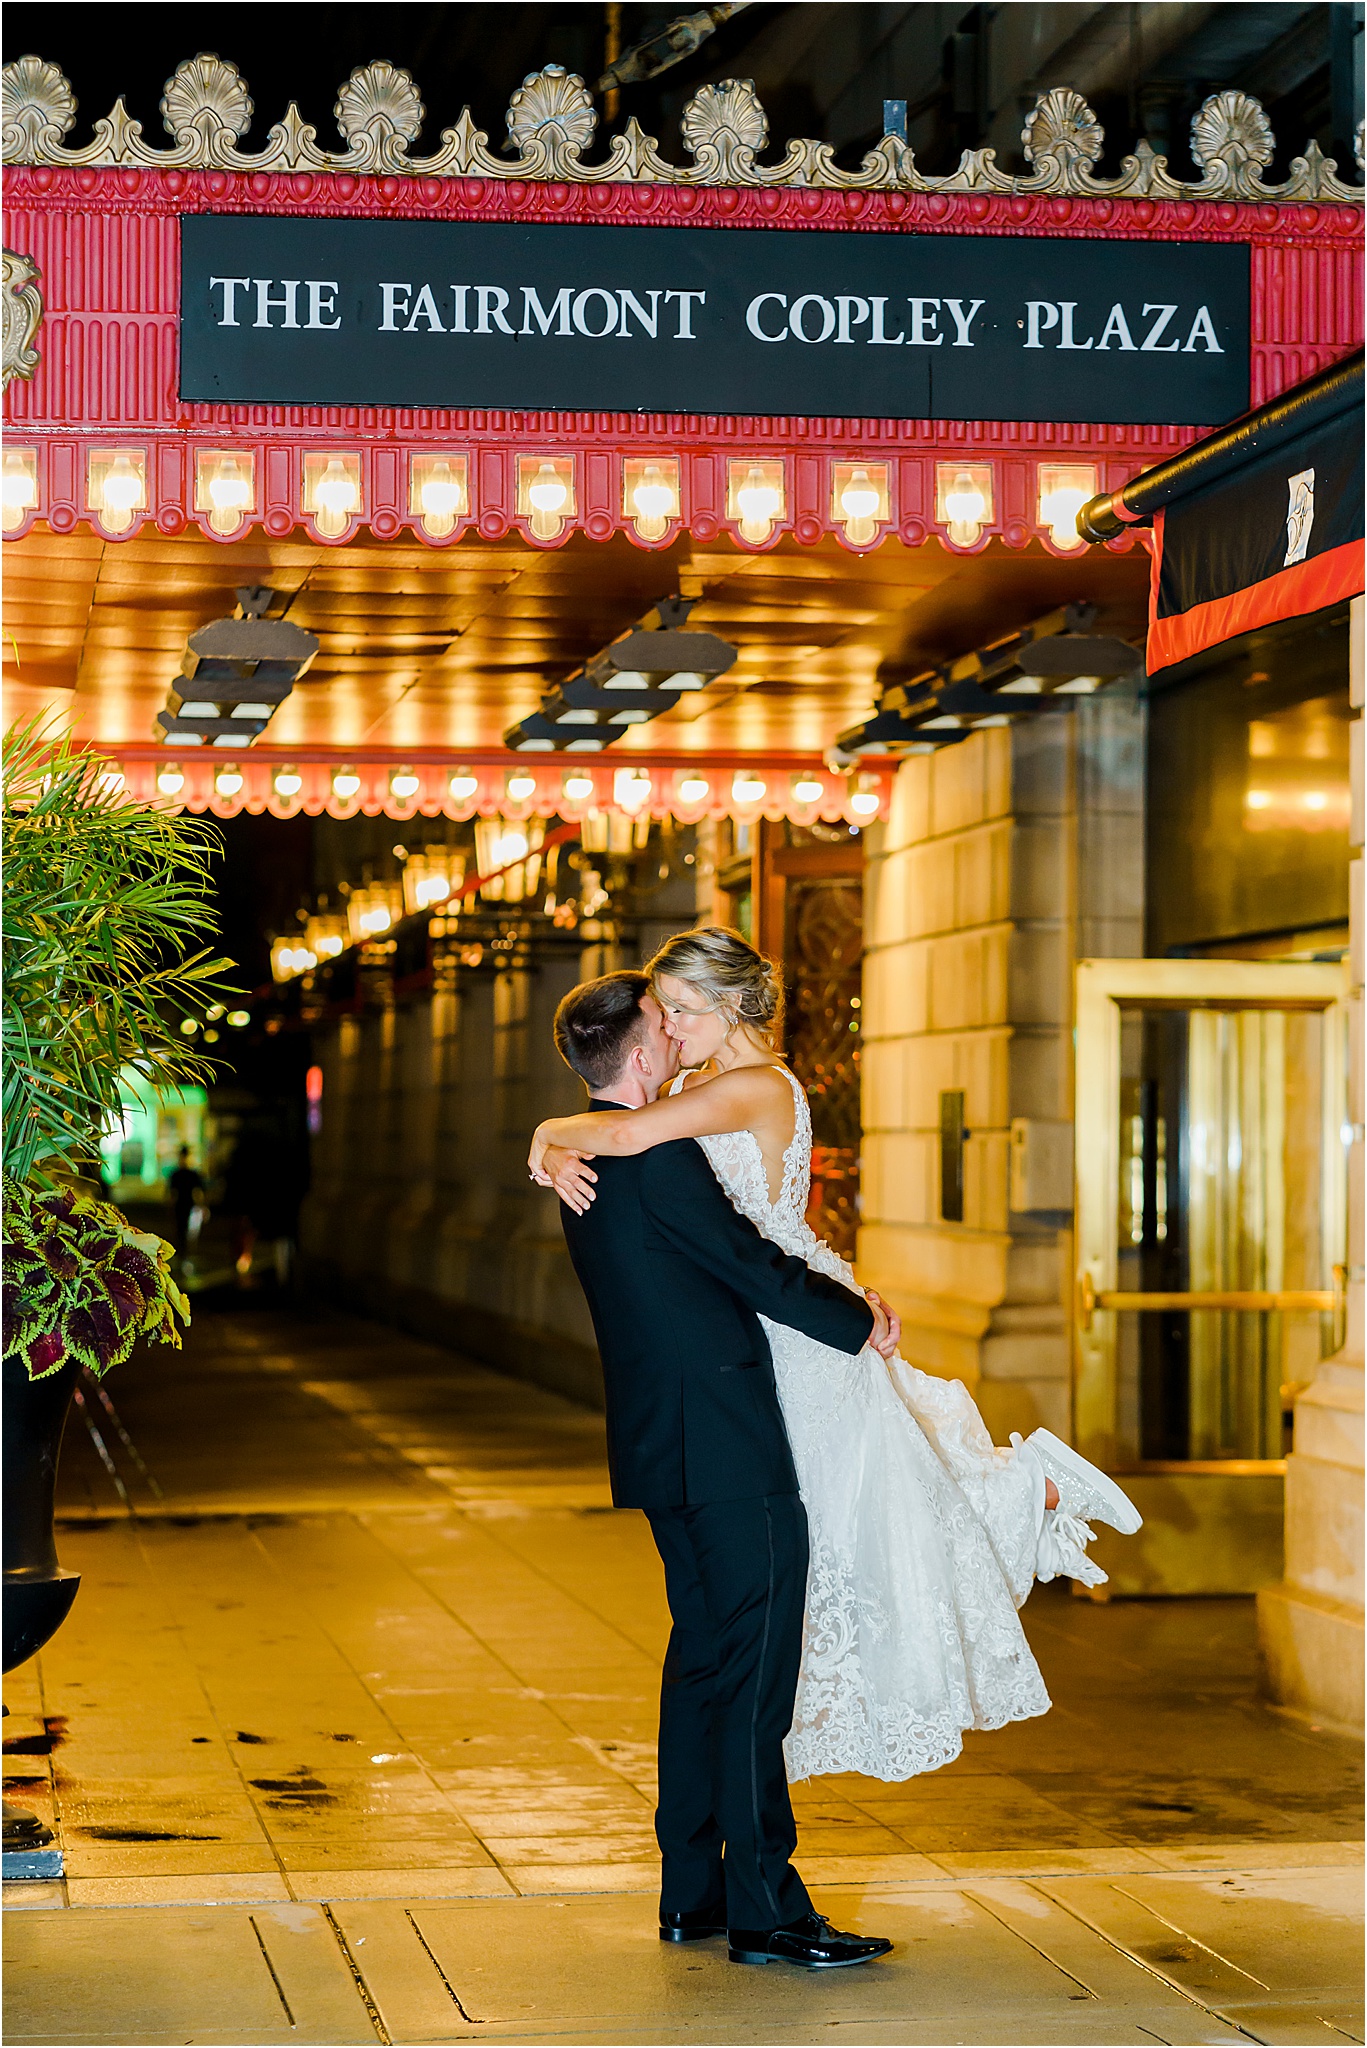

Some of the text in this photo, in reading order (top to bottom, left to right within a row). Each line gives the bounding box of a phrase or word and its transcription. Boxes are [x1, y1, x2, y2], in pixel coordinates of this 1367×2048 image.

[209, 276, 1225, 353] THE FAIRMONT COPLEY PLAZA
